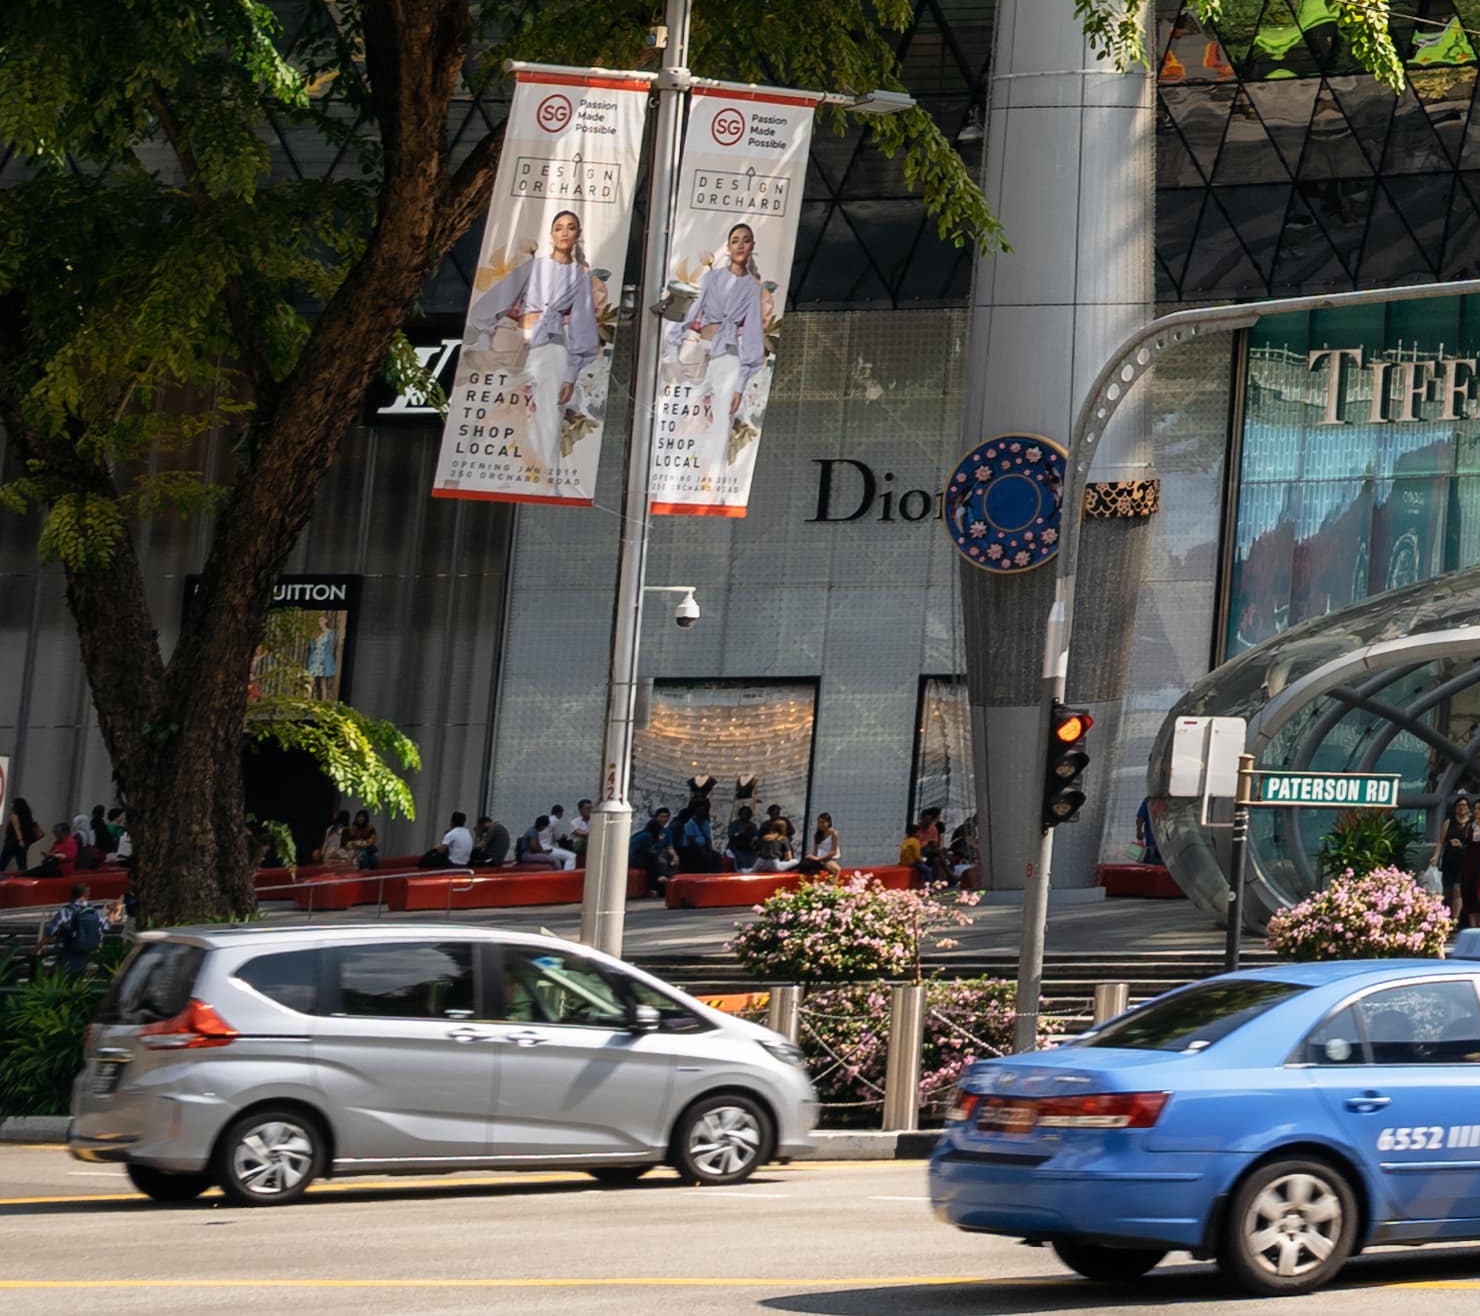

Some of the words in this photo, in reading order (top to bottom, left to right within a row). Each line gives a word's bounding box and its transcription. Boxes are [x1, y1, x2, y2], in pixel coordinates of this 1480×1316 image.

[542, 103, 568, 122] SG
[580, 98, 618, 112] Passion
[578, 111, 605, 123] Made
[751, 113, 788, 126] Passion
[575, 123, 617, 137] Possible
[715, 118, 741, 136] SG
[750, 126, 776, 138] Made
[748, 137, 787, 151] Possible
[522, 158, 613, 182] DESIGN
[518, 179, 612, 199] ORCHARD
[699, 171, 785, 196] DESIGN
[697, 192, 782, 212] ORCHARD
[470, 373, 508, 386] GET
[466, 390, 533, 407] READY
[664, 385, 692, 399] GET
[464, 408, 486, 420] TO
[663, 402, 712, 417] READY
[459, 425, 515, 438] SHOP
[661, 420, 676, 433] TO
[456, 441, 522, 458] LOCAL
[658, 437, 695, 450] SHOP
[452, 460, 510, 472] OPENING
[518, 465, 541, 475] JAN
[655, 454, 701, 469] LOCAL
[449, 469, 473, 479] 250
[480, 471, 540, 484] ORCHARD
[547, 478, 580, 486] ROAD
[273, 583, 346, 601] UITTON
[1267, 777, 1360, 801] PATERSON
[1365, 780, 1390, 802] RD
[1377, 1126, 1444, 1150] 6552
